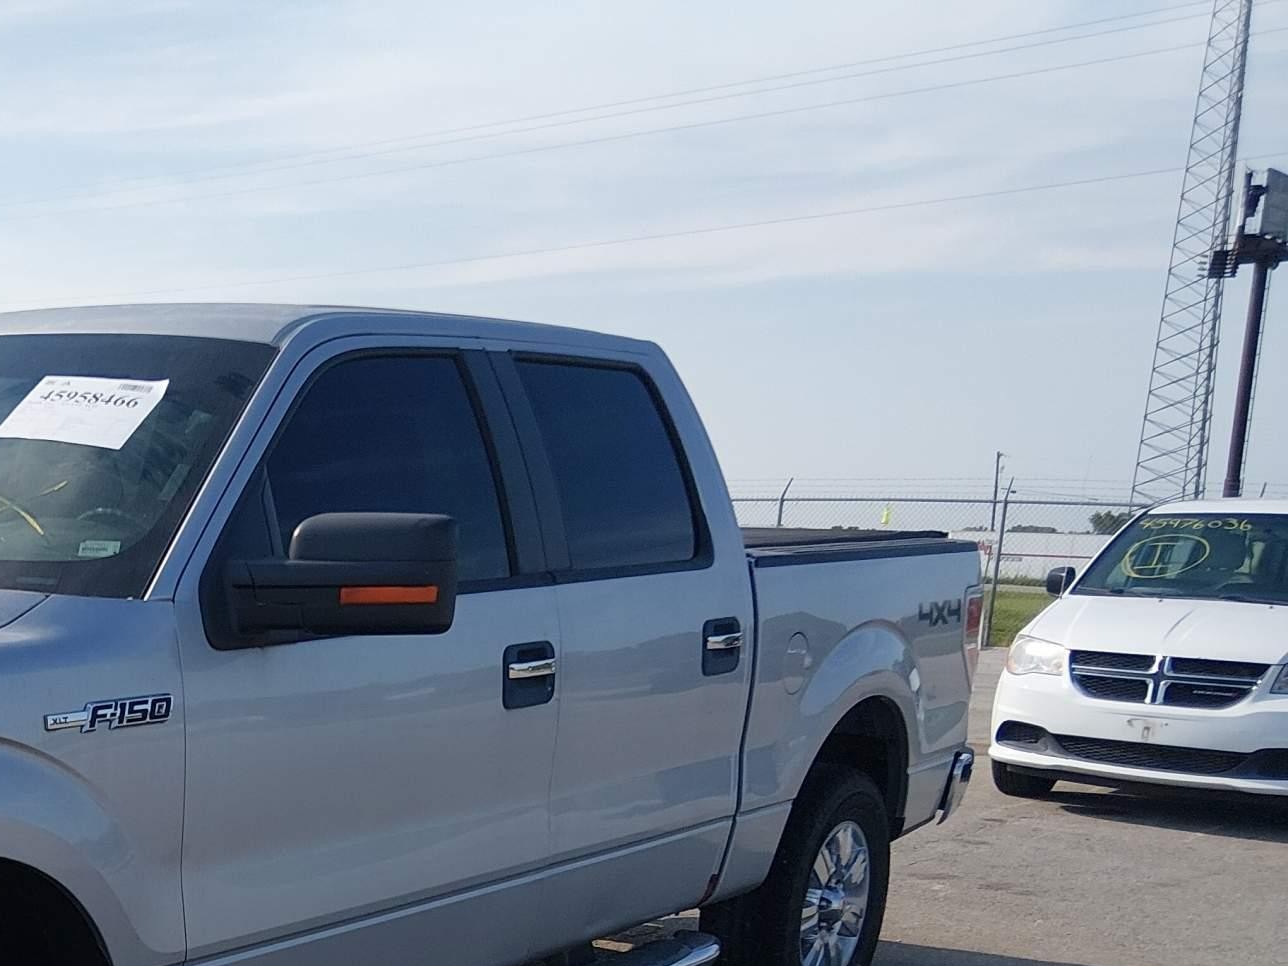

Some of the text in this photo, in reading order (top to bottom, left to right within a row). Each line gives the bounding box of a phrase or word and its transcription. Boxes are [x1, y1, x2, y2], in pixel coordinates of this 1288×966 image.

[40, 389, 142, 409] 45958466
[1140, 517, 1253, 532] 45976036
[50, 696, 173, 731] XLT F-150
